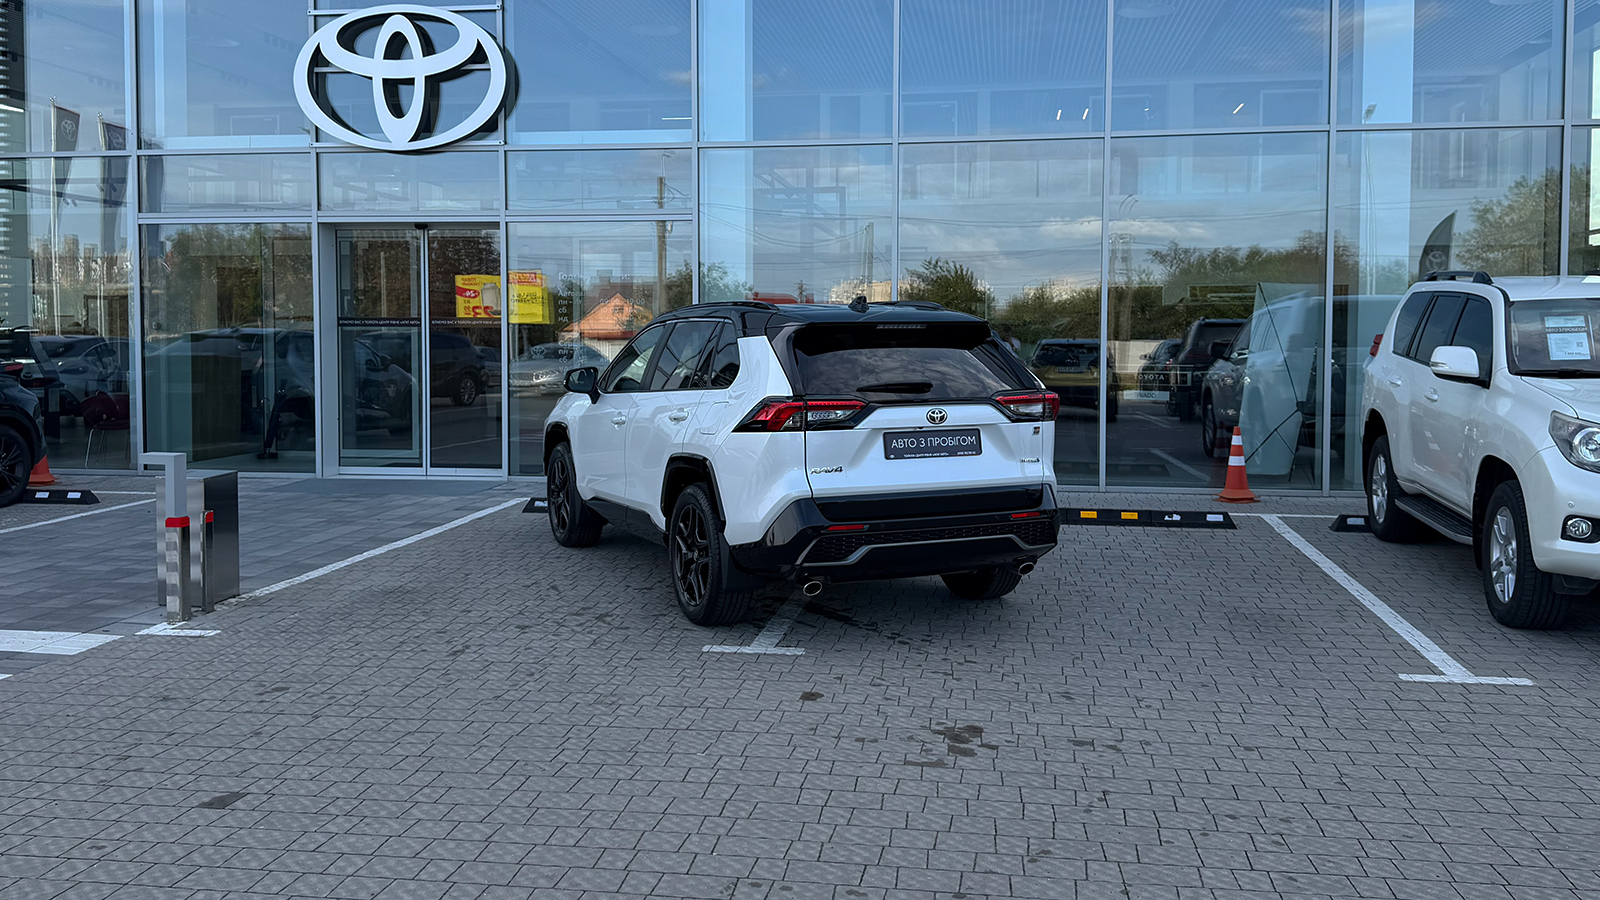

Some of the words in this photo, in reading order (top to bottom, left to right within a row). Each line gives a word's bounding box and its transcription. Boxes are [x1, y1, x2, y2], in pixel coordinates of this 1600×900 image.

[891, 438, 917, 448] АВТО
[927, 436, 976, 447] ПРОБІГОМ
[810, 465, 844, 475] RAV4
